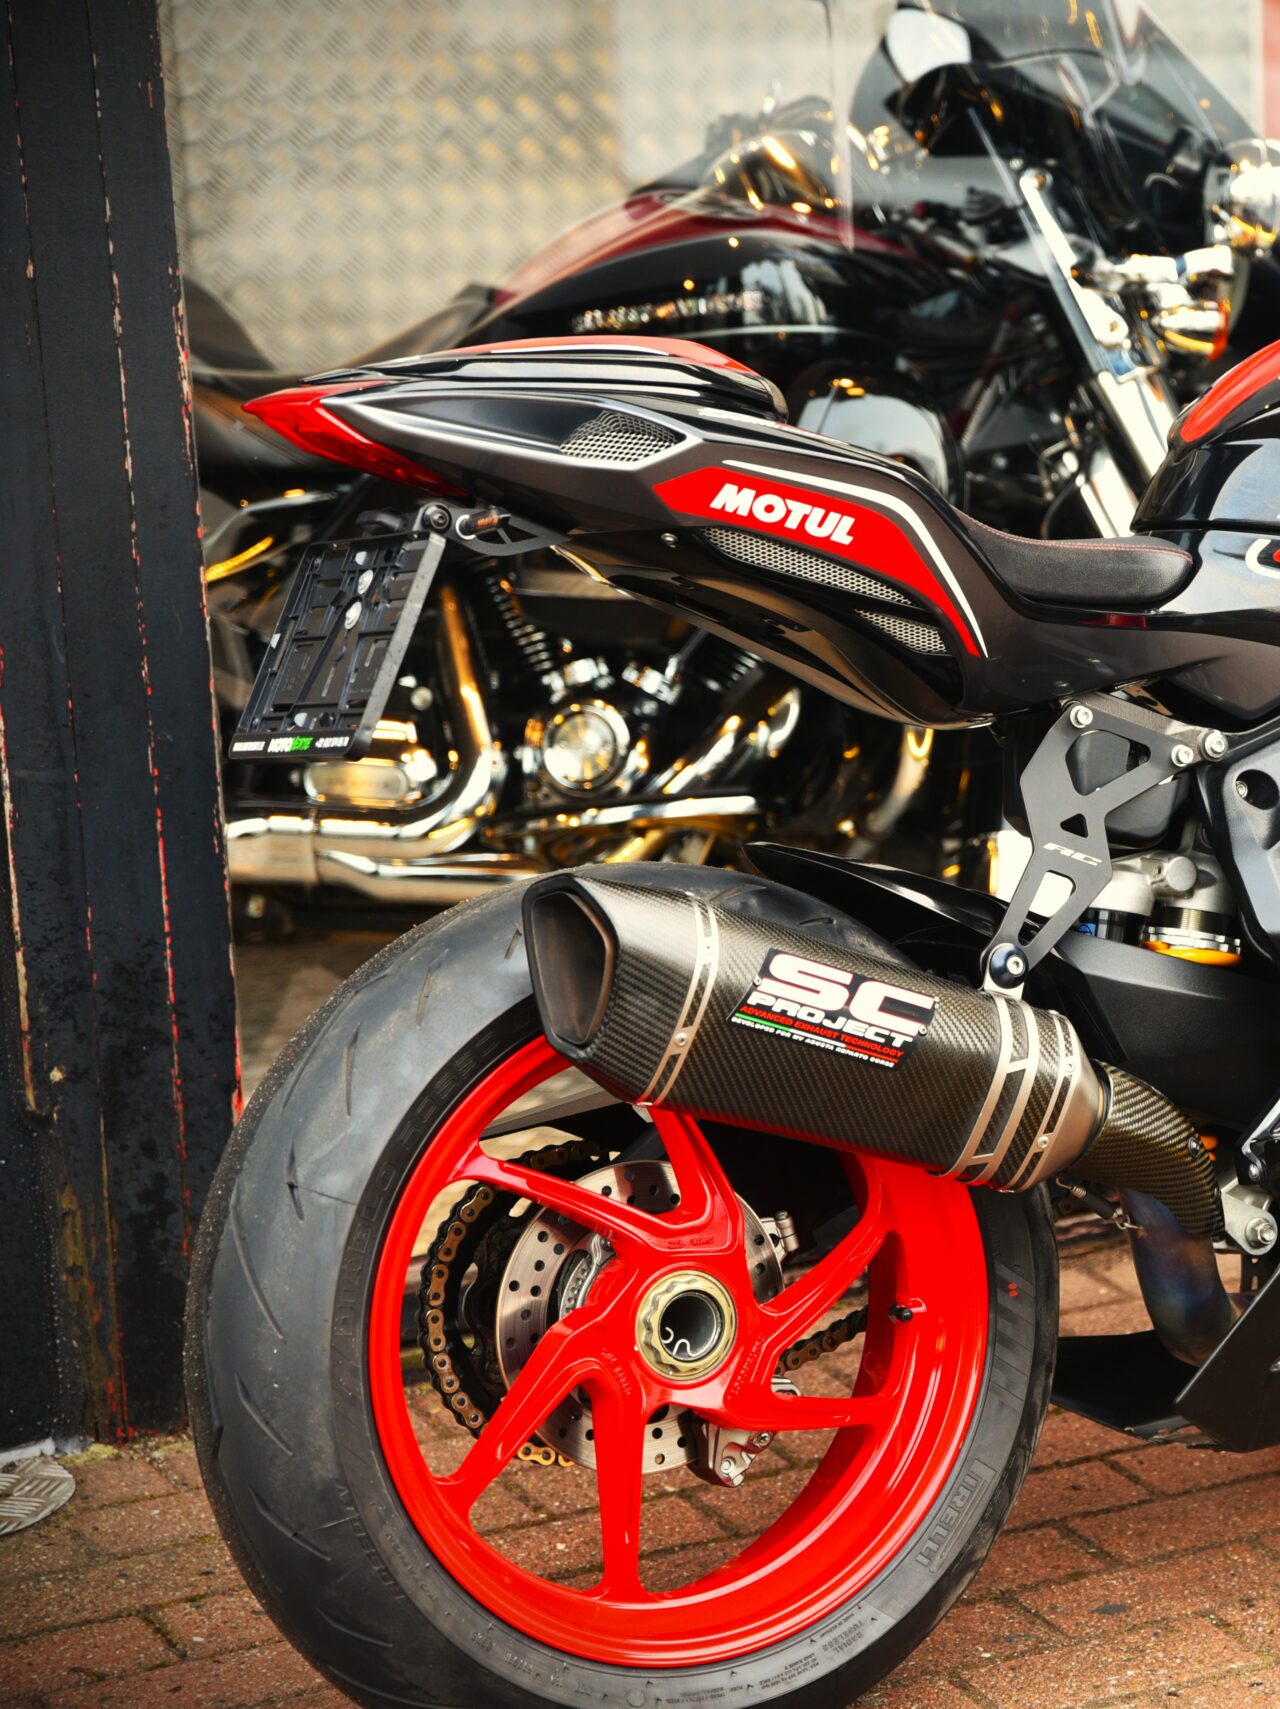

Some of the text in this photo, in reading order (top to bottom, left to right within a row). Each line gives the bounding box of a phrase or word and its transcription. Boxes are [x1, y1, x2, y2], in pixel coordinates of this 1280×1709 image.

[709, 483, 856, 545] MOTUL
[1043, 842, 1102, 866] RC
[747, 990, 913, 1048] PROJECT
[756, 953, 935, 1037] SC
[731, 1016, 775, 1034] DEVELOPED
[776, 1029, 792, 1038] FOR
[804, 1038, 834, 1051] AGUSTA
[835, 1046, 869, 1061] REPARTO
[739, 1005, 904, 1058] ADVANCED EXHAUST TECHNOLOGY
